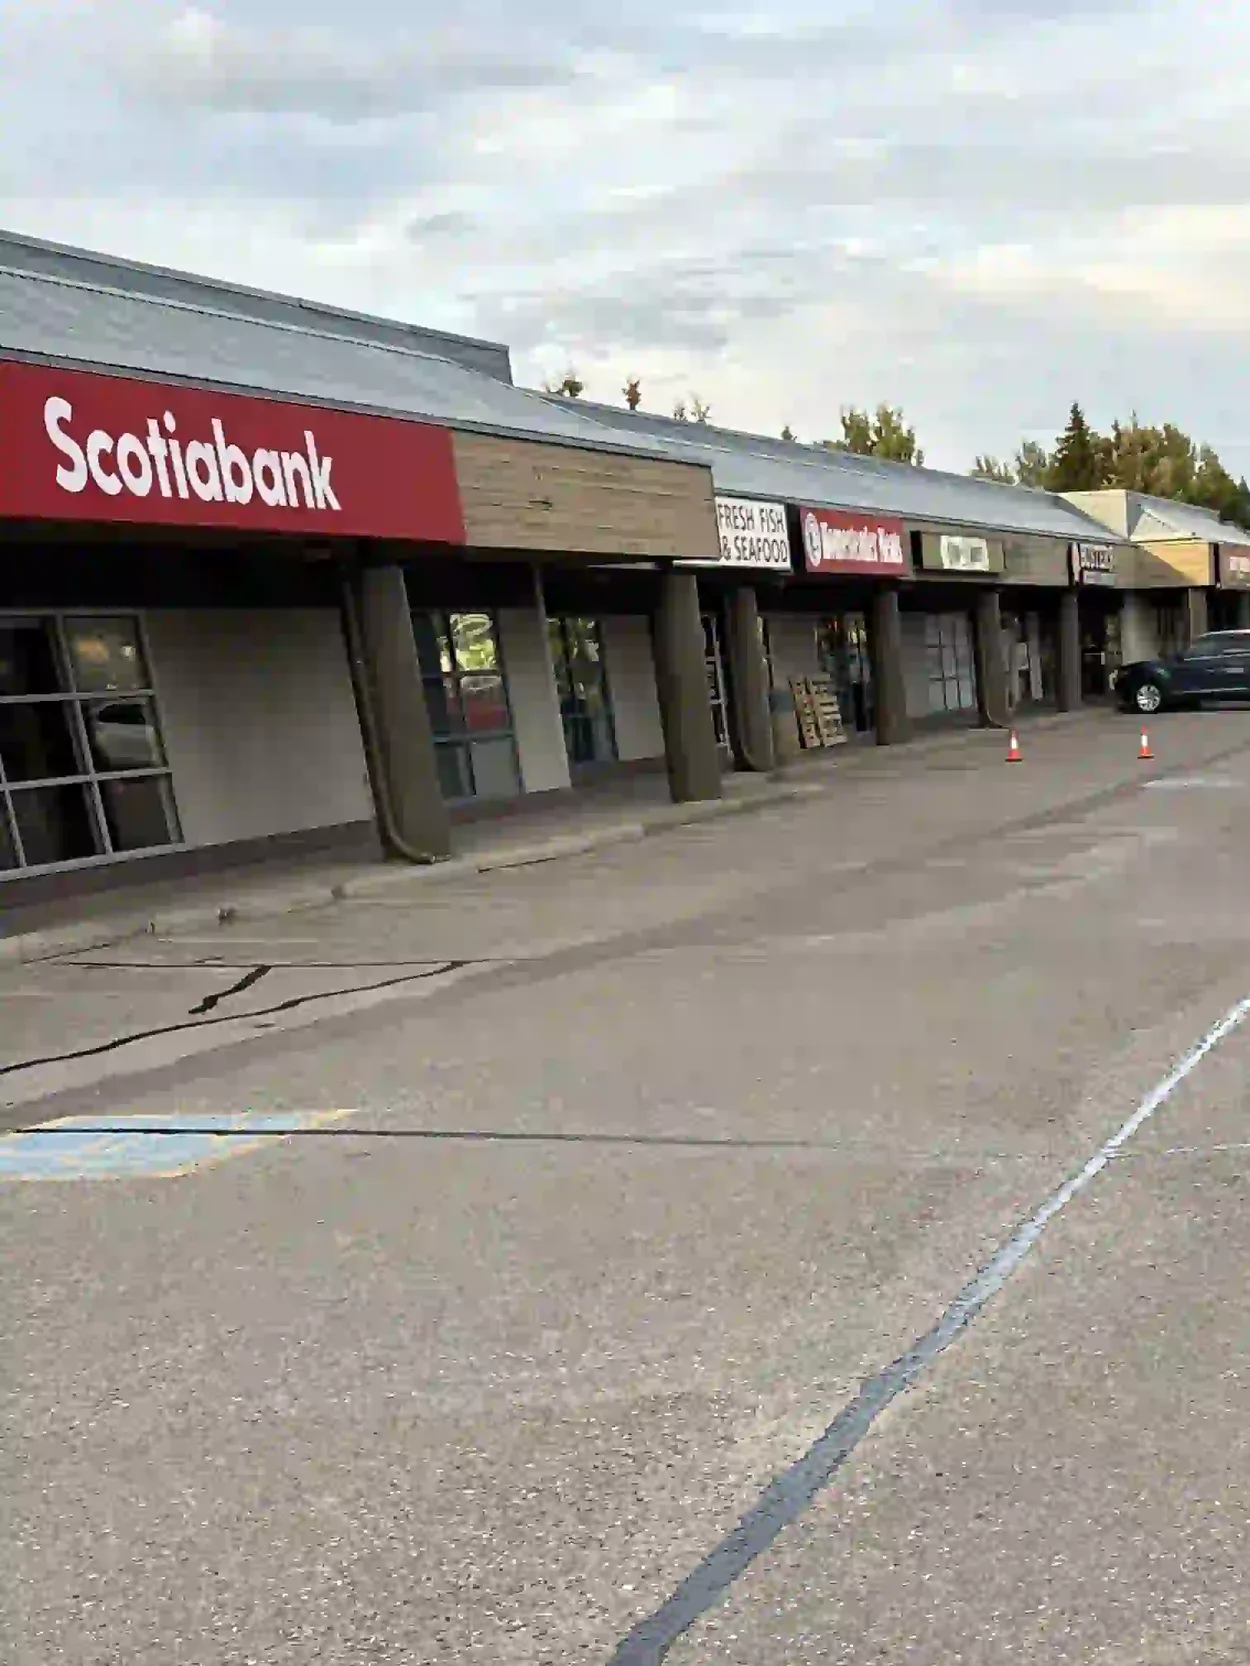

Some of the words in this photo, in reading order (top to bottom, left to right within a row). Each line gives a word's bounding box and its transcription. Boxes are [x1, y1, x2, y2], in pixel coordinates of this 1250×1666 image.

[44, 396, 342, 511] Scotiabank
[717, 503, 755, 531] FRESH
[760, 508, 785, 533] FISH
[722, 535, 731, 561] &
[734, 535, 788, 563] SEAFOOD
